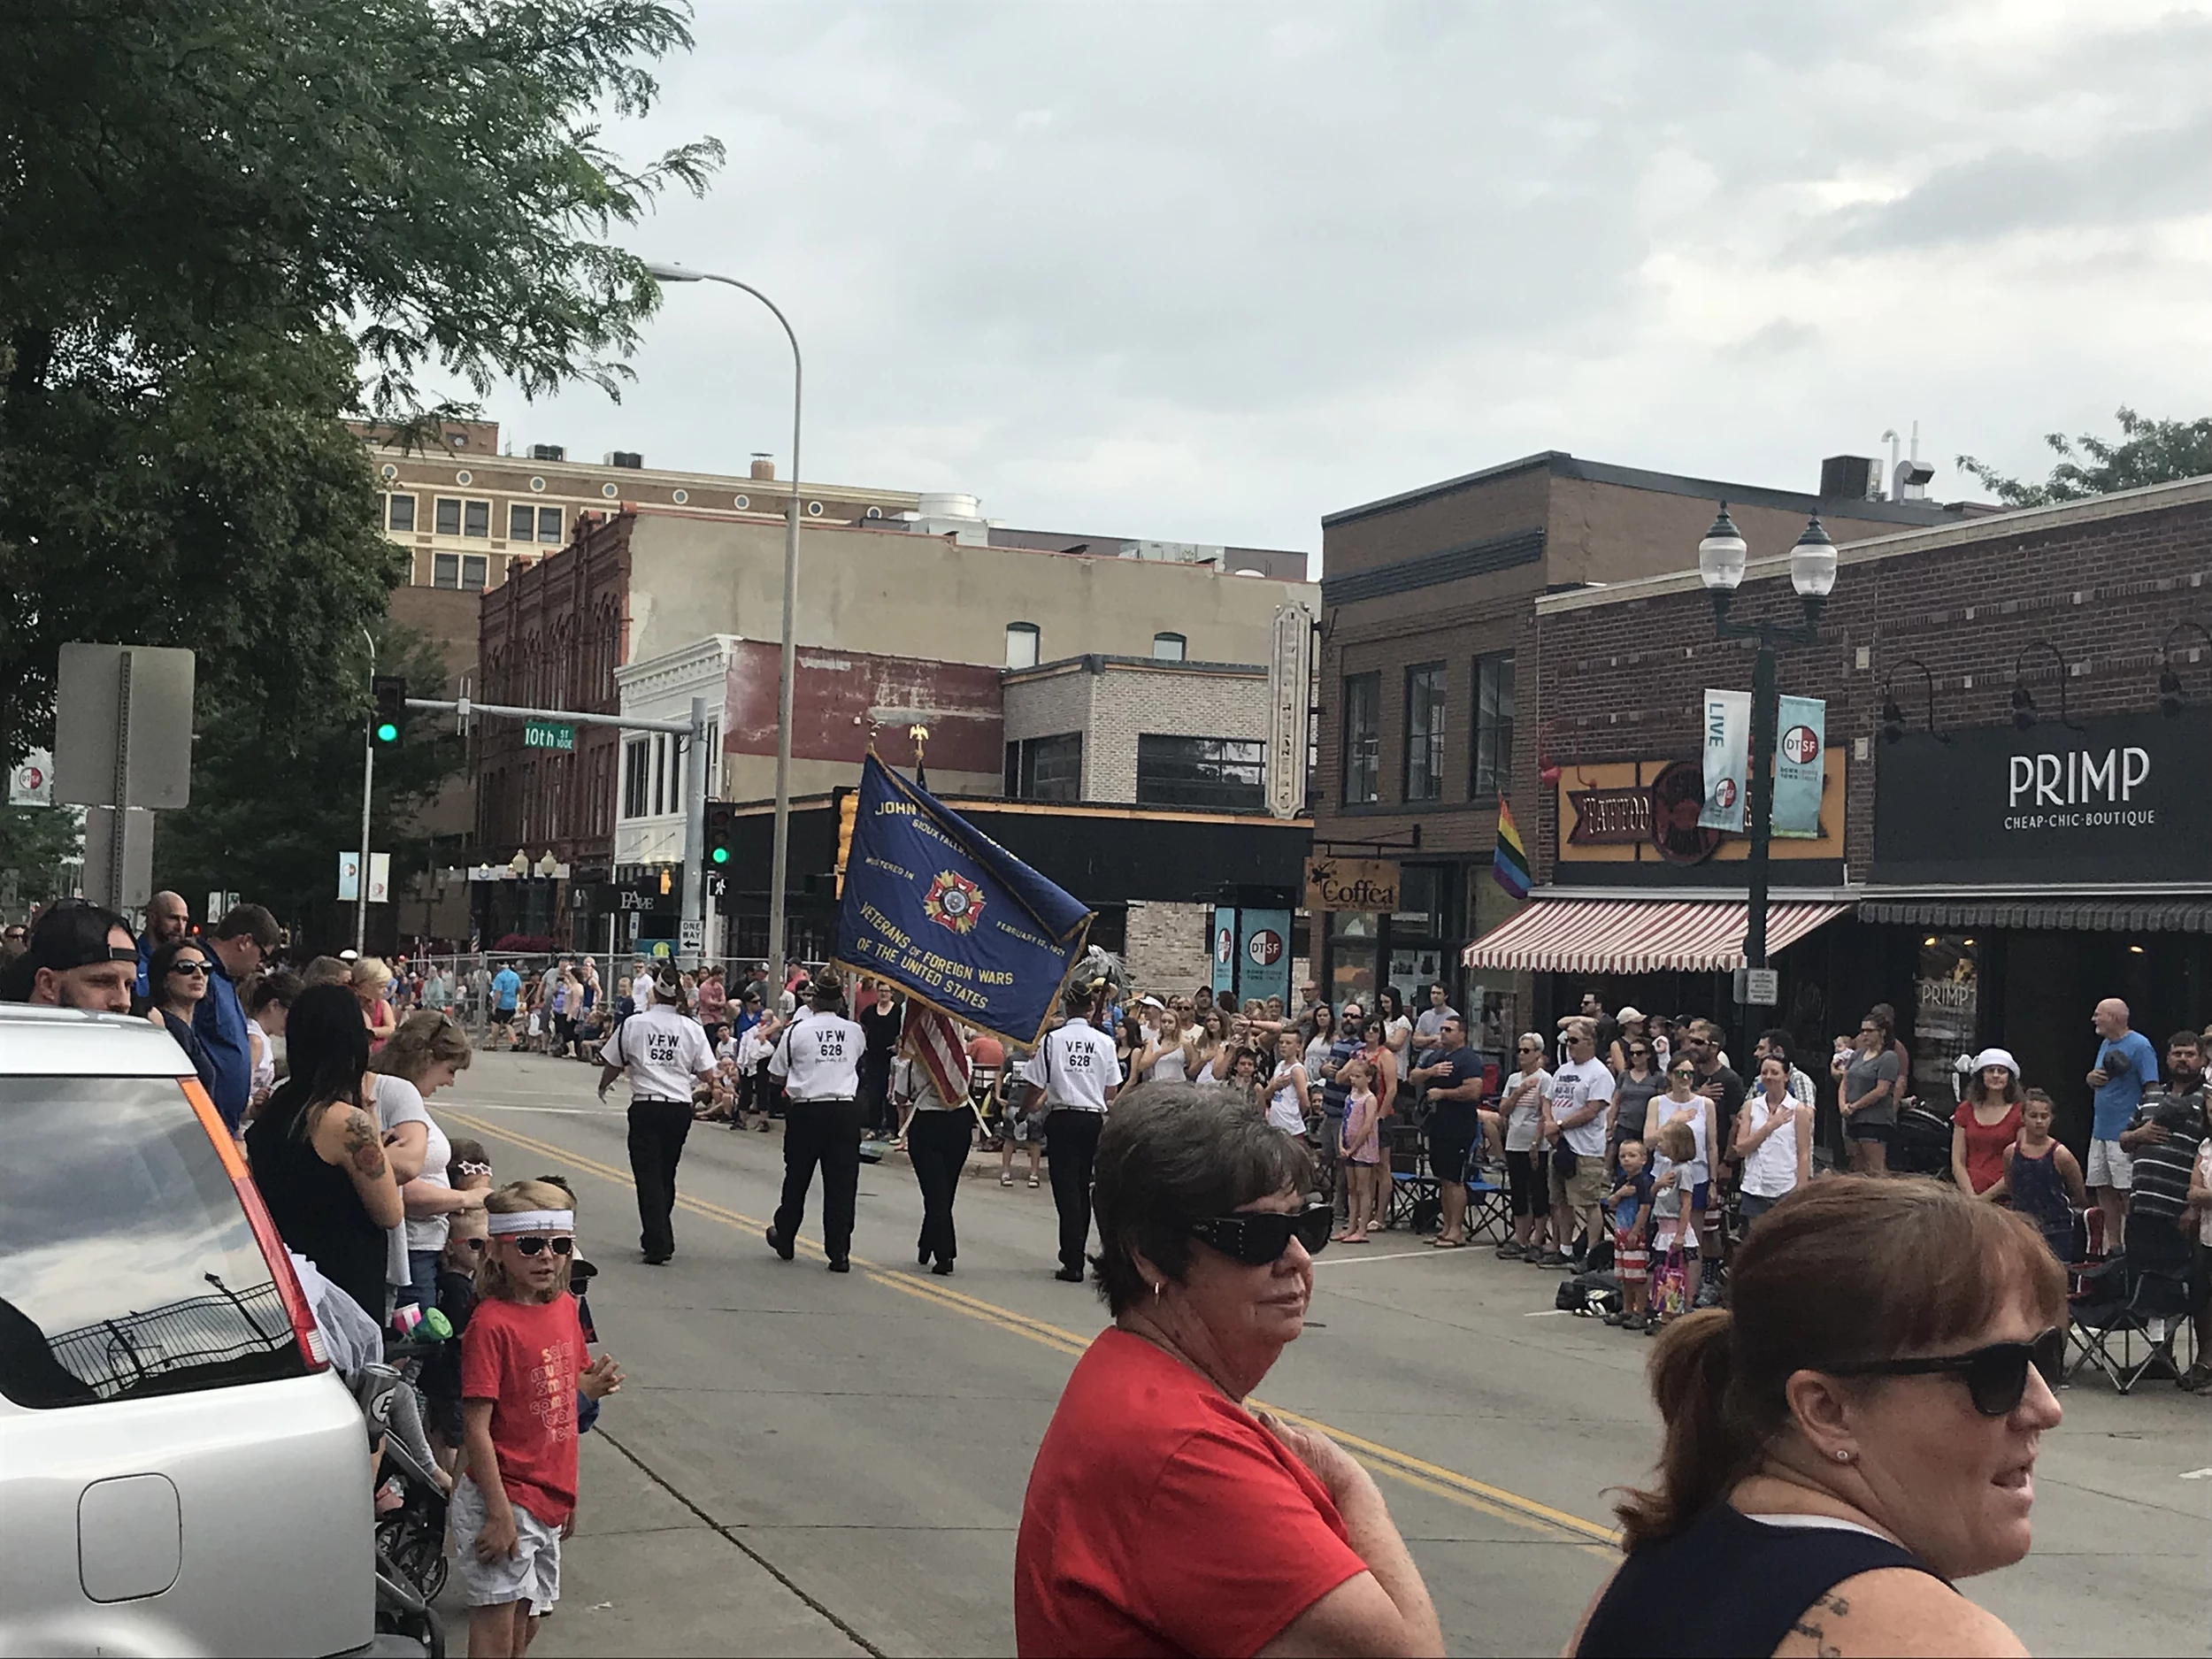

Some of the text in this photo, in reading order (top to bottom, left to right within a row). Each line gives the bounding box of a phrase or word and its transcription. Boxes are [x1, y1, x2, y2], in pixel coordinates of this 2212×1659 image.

[1709, 703, 1724, 748] LIVE
[526, 727, 555, 747] 10th
[2009, 747, 2150, 807] PRIMP
[875, 801, 917, 815] JOHN
[912, 819, 938, 839] SIOUX
[904, 871, 915, 880] IN
[996, 920, 1037, 943] FEBRUARY
[859, 902, 1013, 985] VETERANS OF FOREIGN WARS
[856, 937, 988, 1010] OF THE UNITED STATES
[1923, 985, 1969, 1006] PRIMP
[650, 1048, 673, 1061] 628
[821, 1044, 842, 1056] 628
[1069, 1055, 1091, 1067] 628
